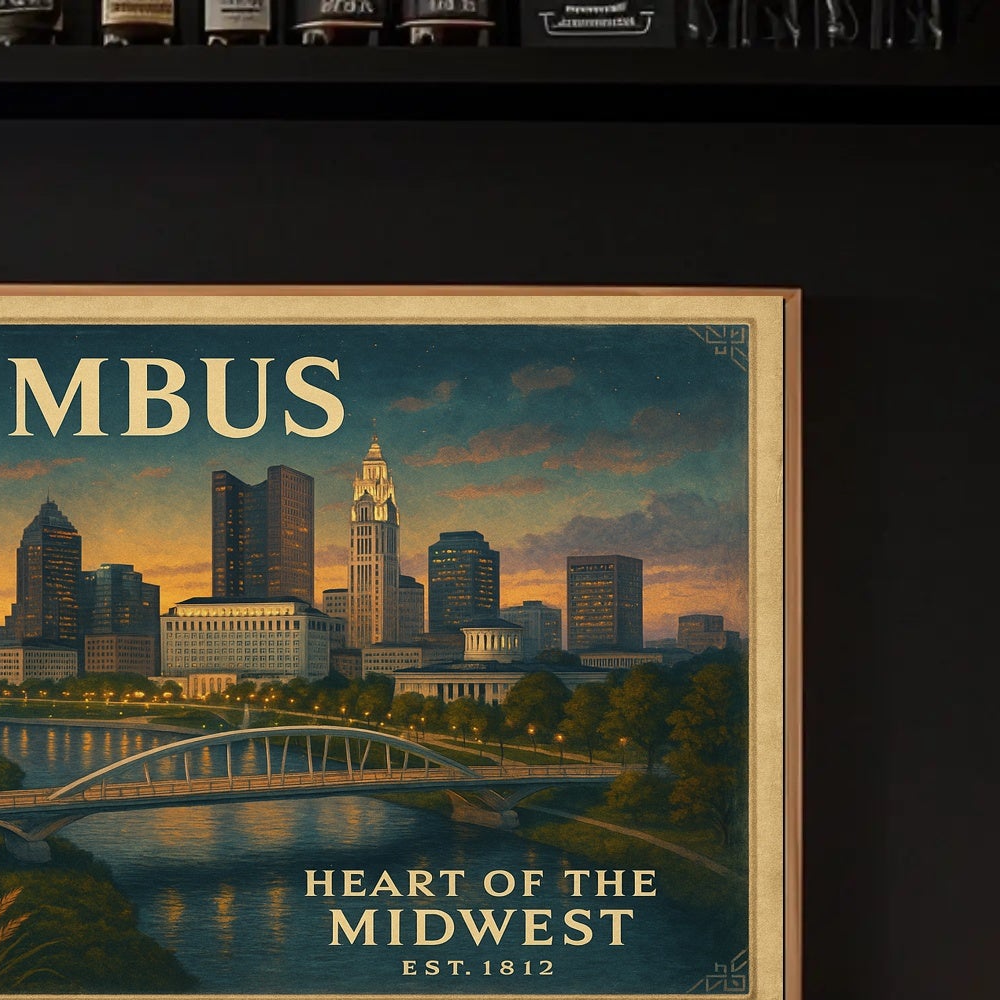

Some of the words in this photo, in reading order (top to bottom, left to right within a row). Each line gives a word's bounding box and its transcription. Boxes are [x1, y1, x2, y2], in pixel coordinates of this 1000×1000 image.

[304, 869, 465, 898] HEART
[483, 869, 544, 898] OF
[564, 869, 658, 898] THE
[328, 908, 635, 947] MIDWEST
